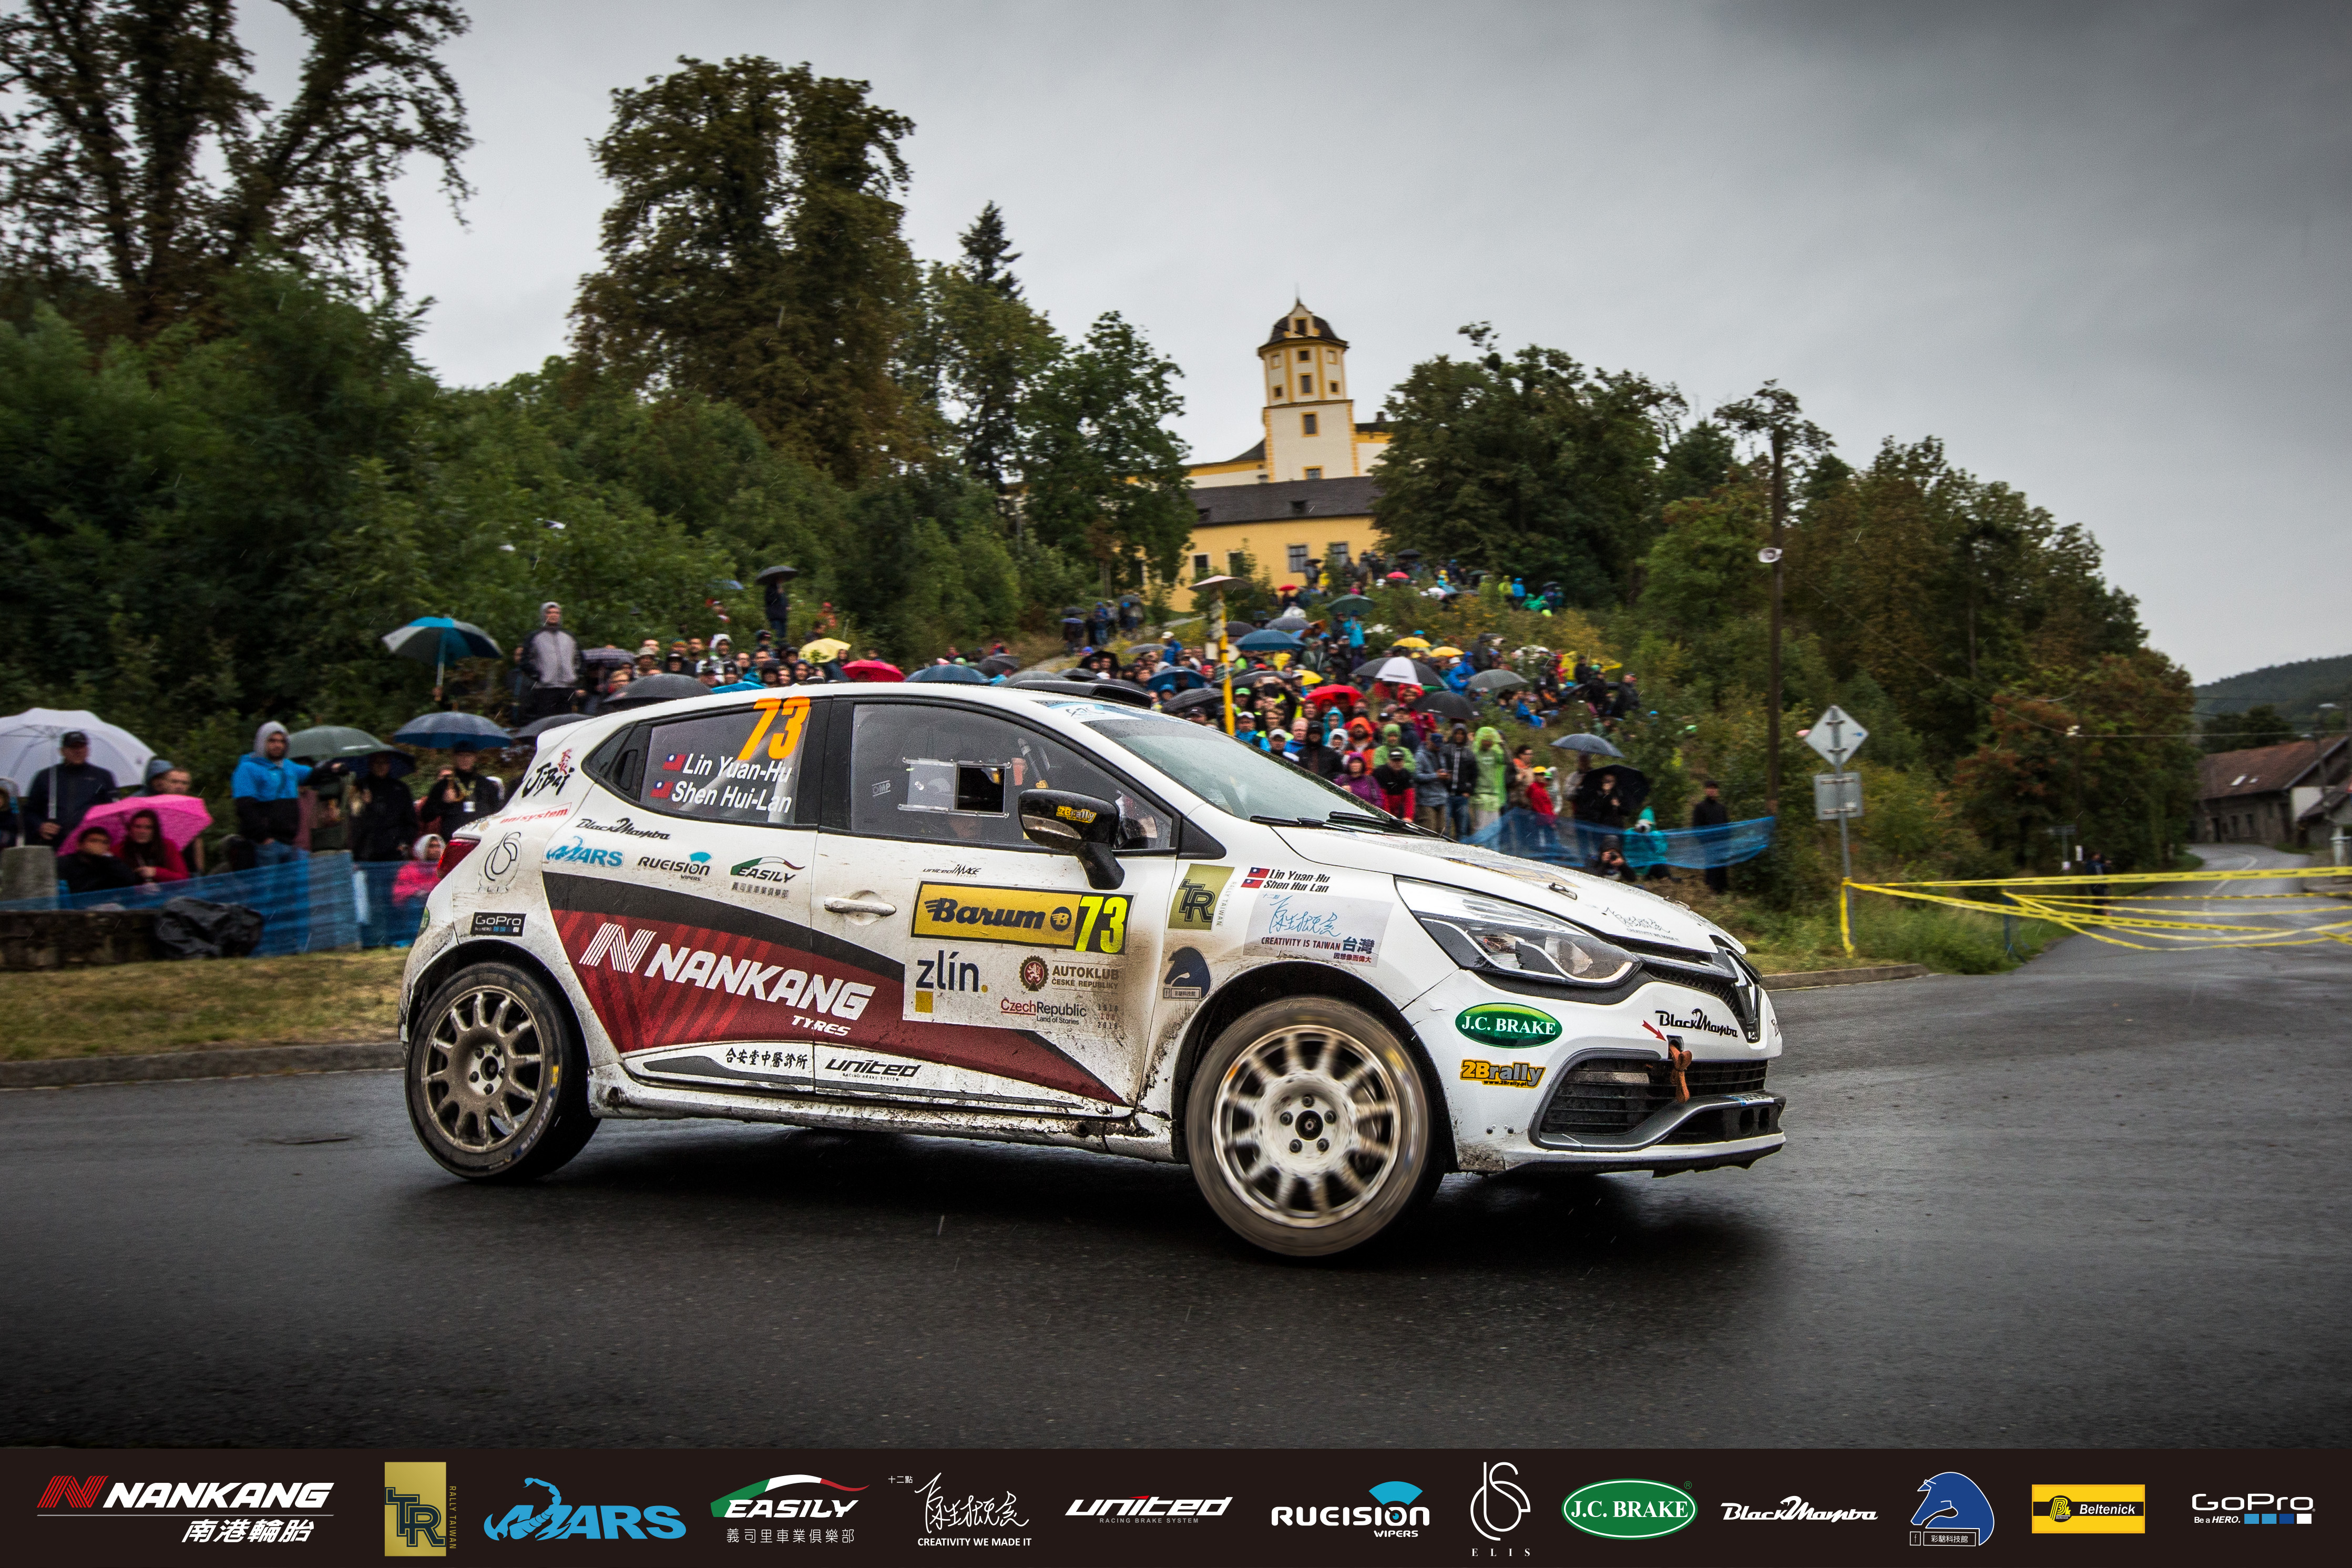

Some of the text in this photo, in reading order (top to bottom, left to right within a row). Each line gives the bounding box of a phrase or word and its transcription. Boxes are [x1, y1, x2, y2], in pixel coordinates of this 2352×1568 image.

[737, 696, 810, 761] 73
[682, 753, 793, 783] Lin Yuan-Hu
[671, 781, 792, 813] Shen Hui-Lan
[546, 837, 624, 867] MARS
[737, 867, 796, 883] EASILY
[1269, 869, 1331, 883] Lin Yuan-Hu
[1263, 880, 1290, 890] Shen
[1309, 884, 1330, 893] Lan
[924, 898, 1046, 929] Barum
[1216, 882, 1237, 926] RALLY TAIWAN
[475, 916, 521, 926] GoPro
[1075, 896, 1128, 953] 73
[1262, 937, 1301, 947] CREATIVITY
[1312, 940, 1341, 951] TAIWAN
[1343, 936, 1375, 954] 台灣
[644, 943, 876, 1020] NANKANG
[1052, 965, 1119, 980] AUTOKLUB
[1051, 978, 1119, 989] ČESKÉ REPUBLIKY
[791, 1015, 852, 1037] TYRES
[1098, 1021, 1118, 1030] 2018
[1461, 1016, 1556, 1035] J.C. BRAKE
[725, 1047, 808, 1070] 合安堂中醫診所
[825, 1058, 922, 1078] united
[1461, 1059, 1546, 1087] 2Brally
